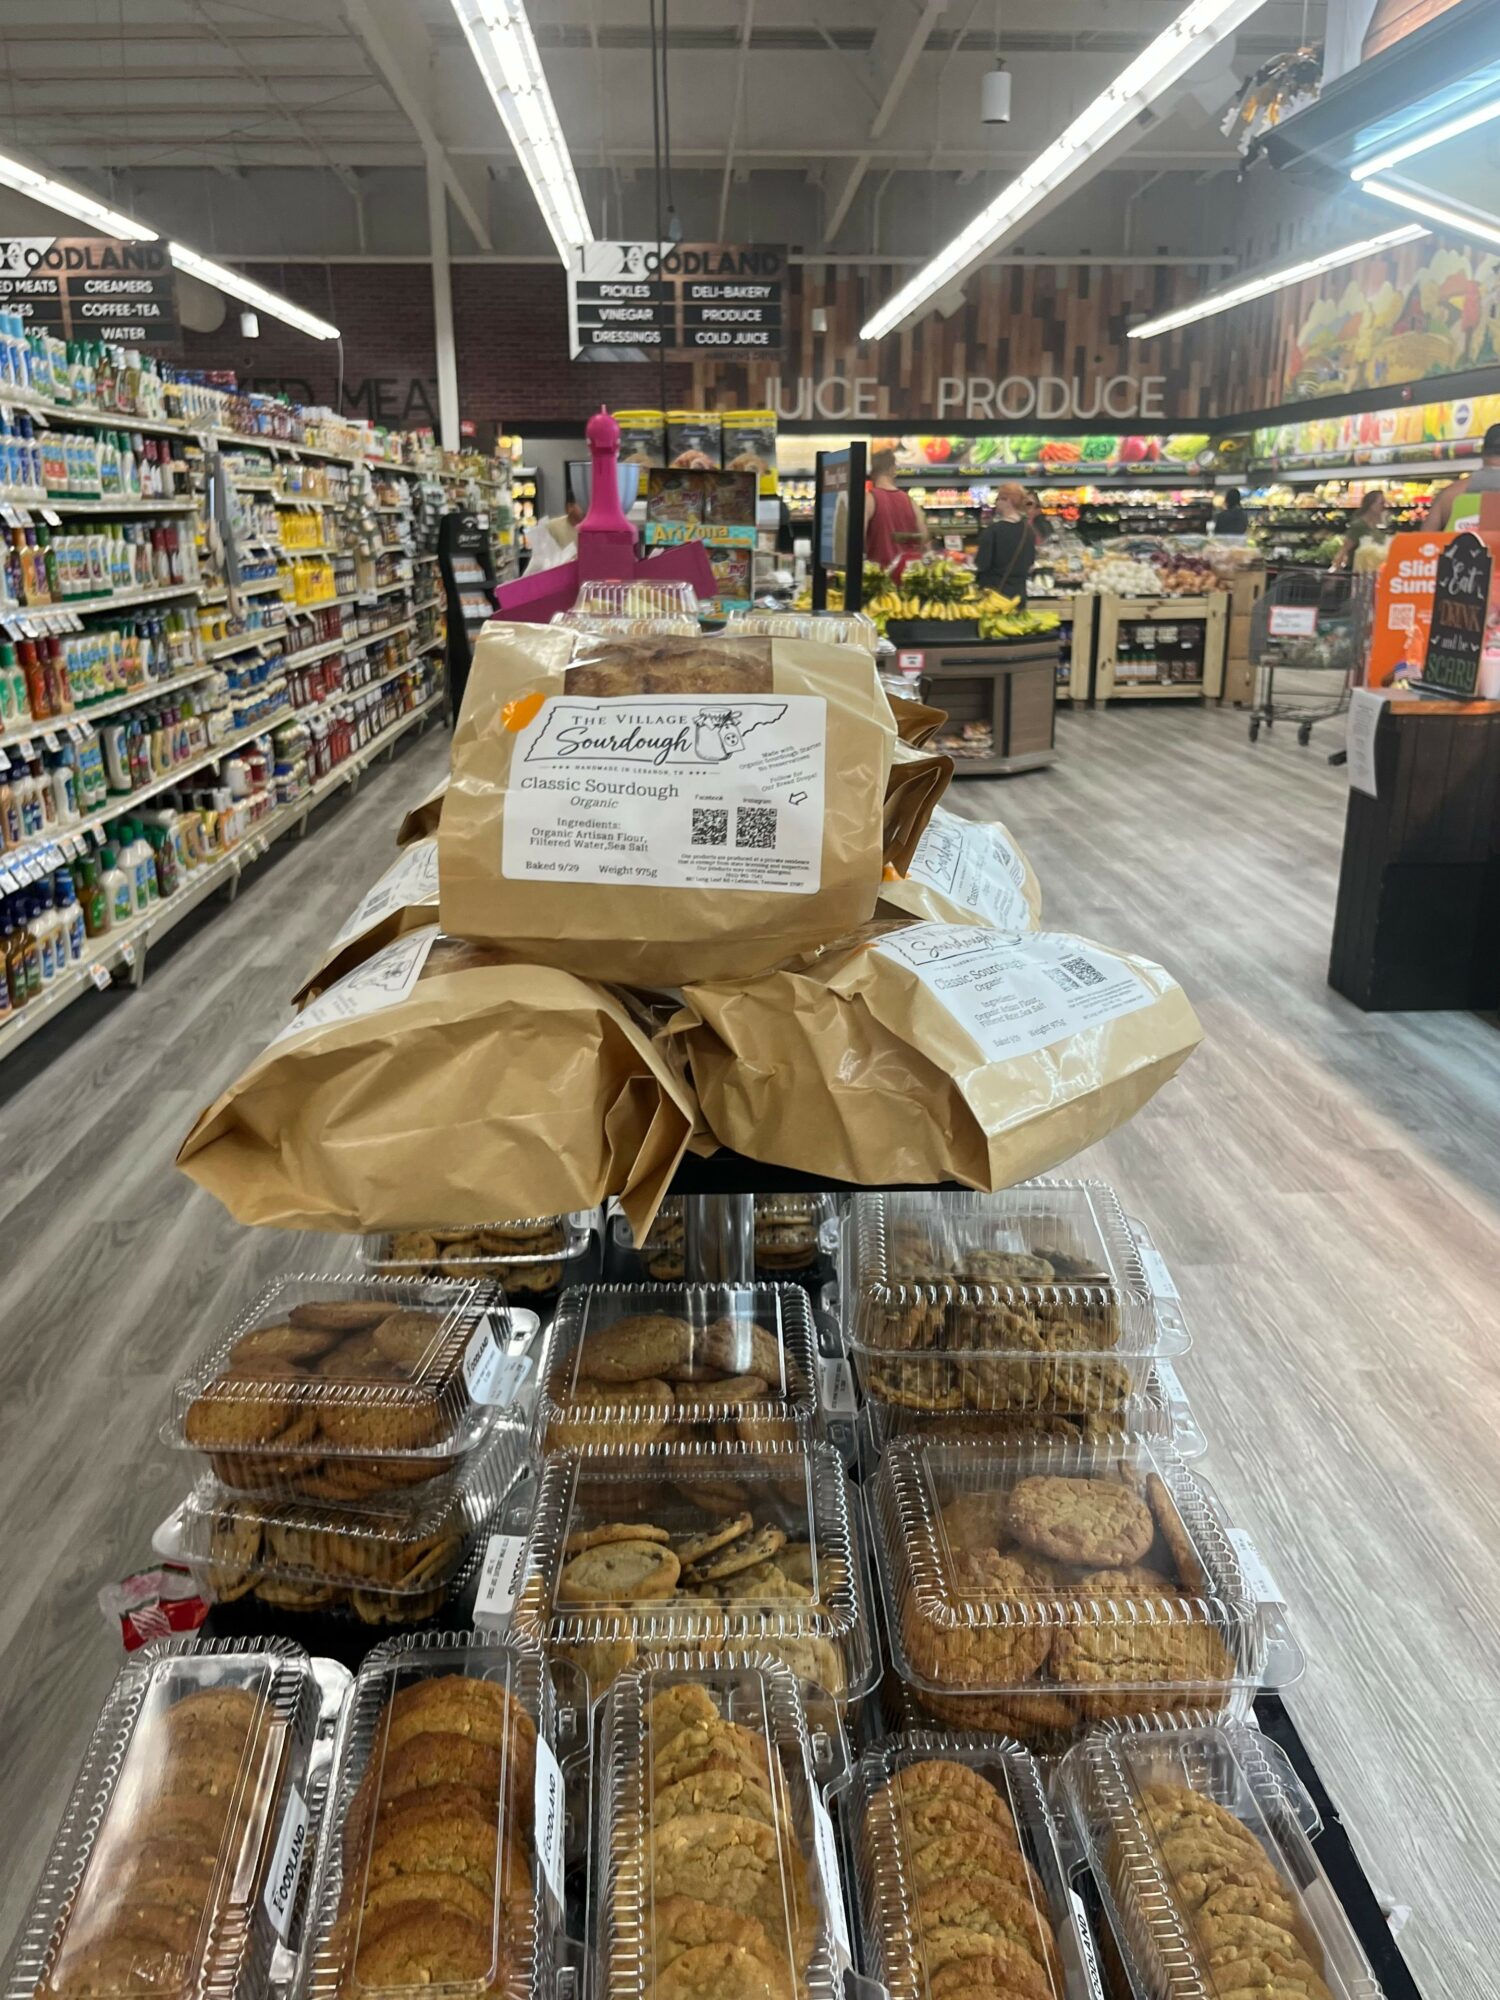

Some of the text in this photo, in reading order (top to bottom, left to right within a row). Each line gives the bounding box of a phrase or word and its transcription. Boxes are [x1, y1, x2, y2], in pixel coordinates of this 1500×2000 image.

[575, 245, 585, 274] 1
[618, 246, 780, 275] FOODLAND
[15, 280, 57, 293] MEATS
[84, 280, 153, 294] CREAMERS
[600, 285, 650, 298] PICKLES
[692, 286, 771, 298] DELI-BAKERY
[81, 303, 160, 316] COFFEE-TEA
[598, 309, 653, 321] VINEGAR
[702, 309, 762, 322] PRODUCE
[101, 326, 146, 340] WATER
[592, 331, 662, 343] DRESSINGS
[695, 332, 769, 344] COLD JUICE
[937, 376, 1167, 419] PRODUCE
[652, 522, 729, 544] AriZona
[1448, 560, 1483, 595] Eat
[1439, 600, 1481, 632] DRINK
[1426, 652, 1477, 690] SCARY
[571, 714, 688, 726] THE VILLAGE
[556, 726, 692, 766] Sourdough
[520, 777, 679, 801] Classic Sourdough
[570, 796, 620, 810] Organic
[557, 818, 621, 830] Ingredients:
[532, 827, 648, 843] Organic Artisan Flour,
[529, 837, 570, 848] Filtered
[629, 843, 648, 852] Salt
[525, 861, 580, 872] Baked 9/29
[599, 865, 658, 878] Weight 975g
[934, 974, 973, 991] Classic
[974, 977, 1004, 992] Organic
[544, 1773, 557, 1864] FOODLAND
[273, 1824, 305, 1917] FOODLAND
